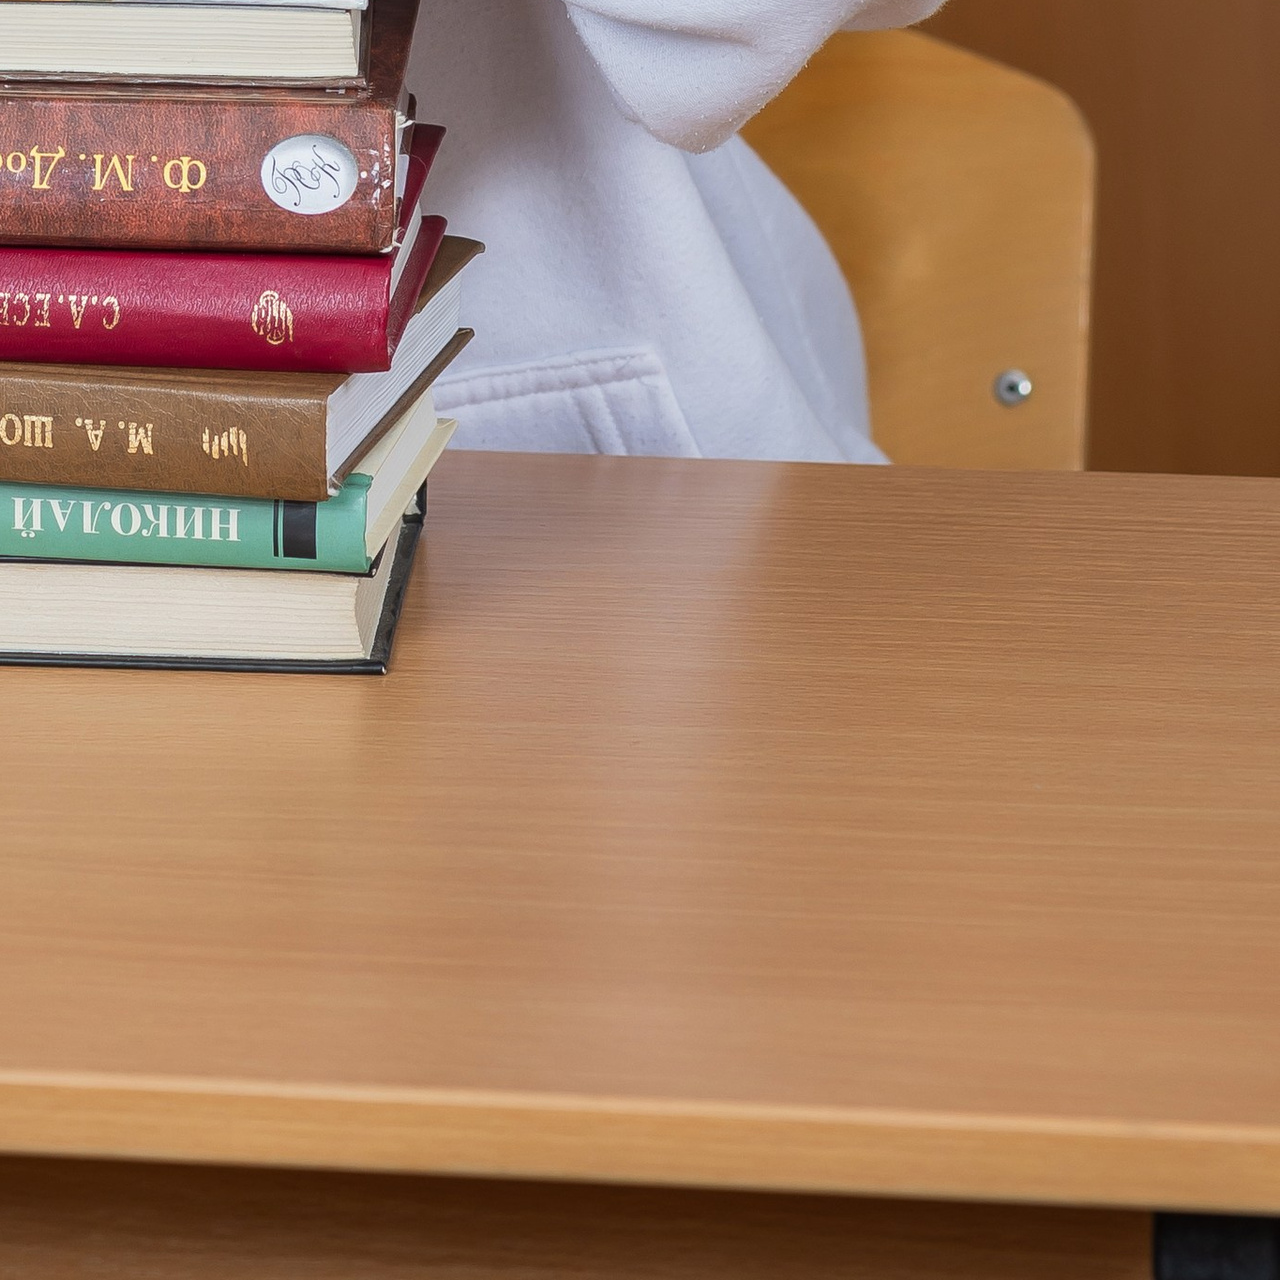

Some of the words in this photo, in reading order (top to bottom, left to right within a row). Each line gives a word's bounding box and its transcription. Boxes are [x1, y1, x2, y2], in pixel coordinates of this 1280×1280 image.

[79, 153, 135, 191] М.
[152, 155, 206, 193] Ф.
[75, 417, 106, 451] А.
[118, 421, 154, 455] М.
[12, 497, 242, 542] НИКОЛАЙ
